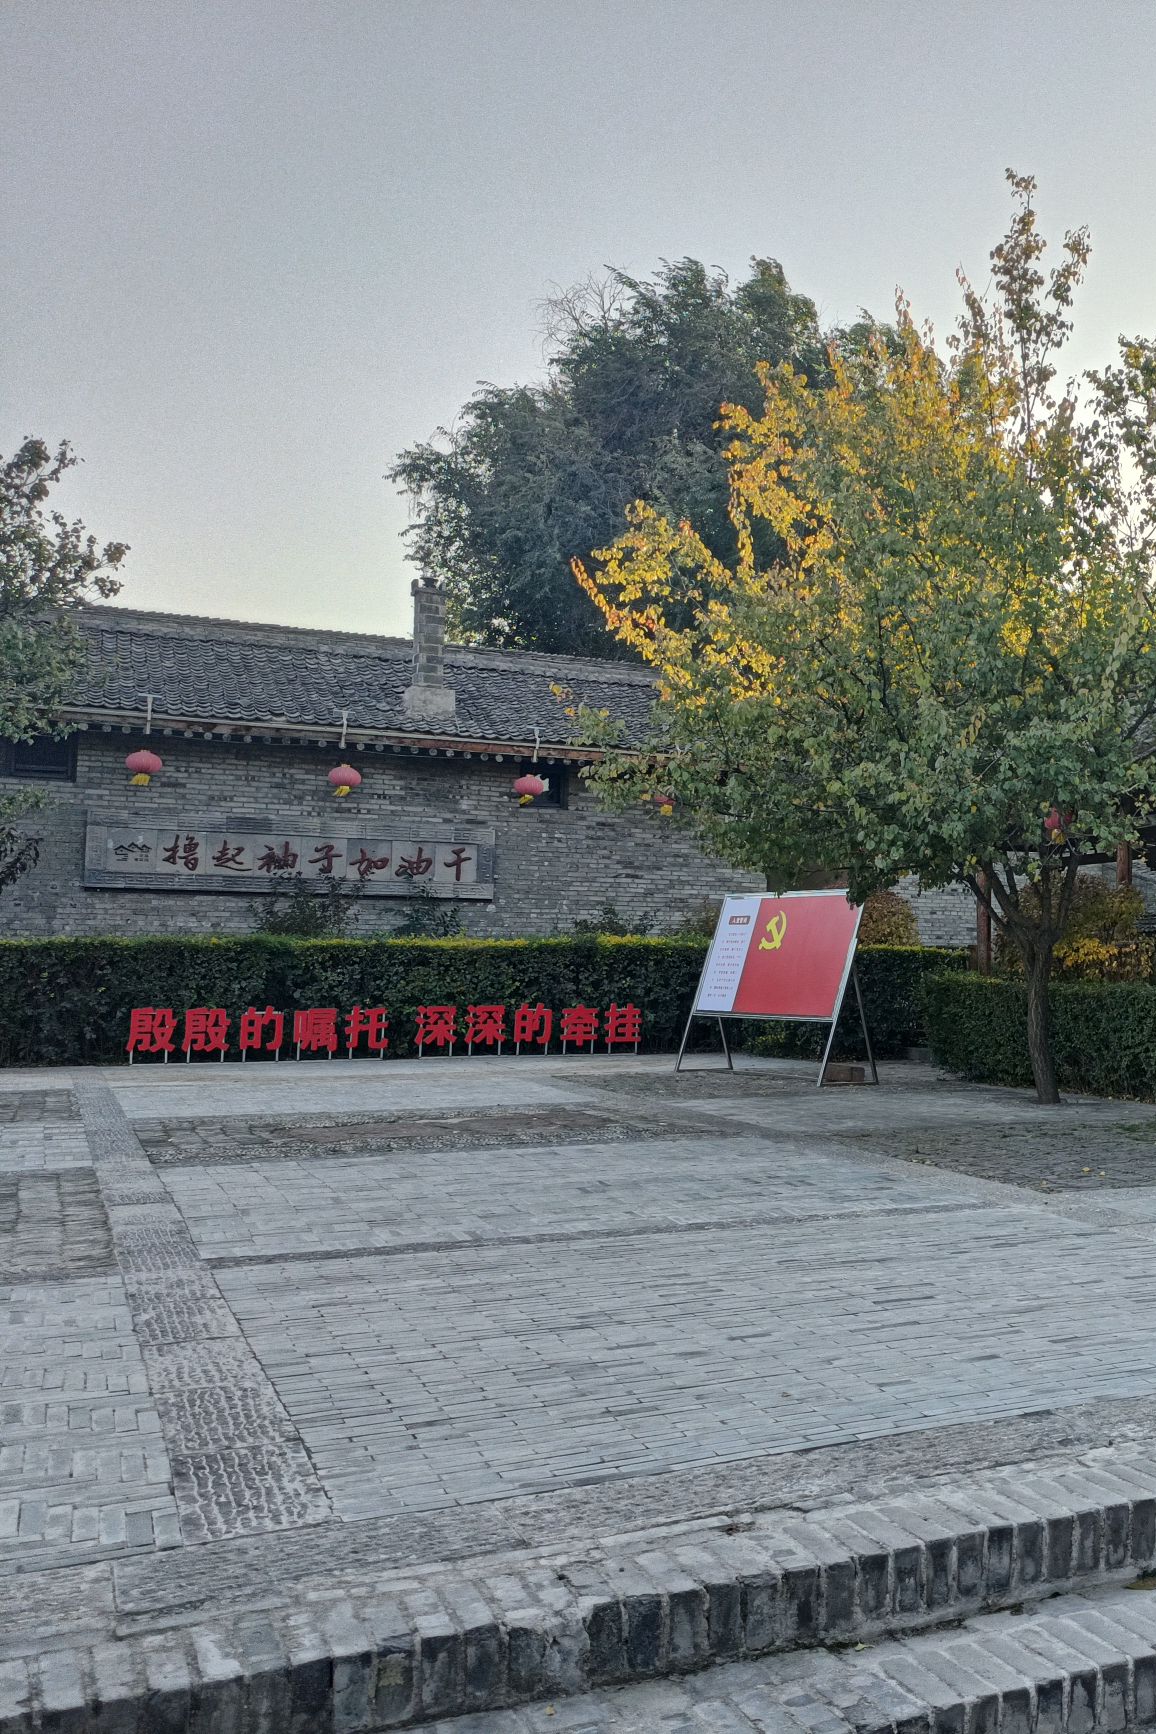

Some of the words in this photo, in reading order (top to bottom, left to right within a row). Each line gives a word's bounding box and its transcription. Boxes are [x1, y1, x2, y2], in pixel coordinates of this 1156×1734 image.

[162, 834, 472, 881] 撸起袖子加油干
[125, 1006, 389, 1052] 殷殷的嘱托
[414, 1003, 642, 1047] 深深的牵挂
